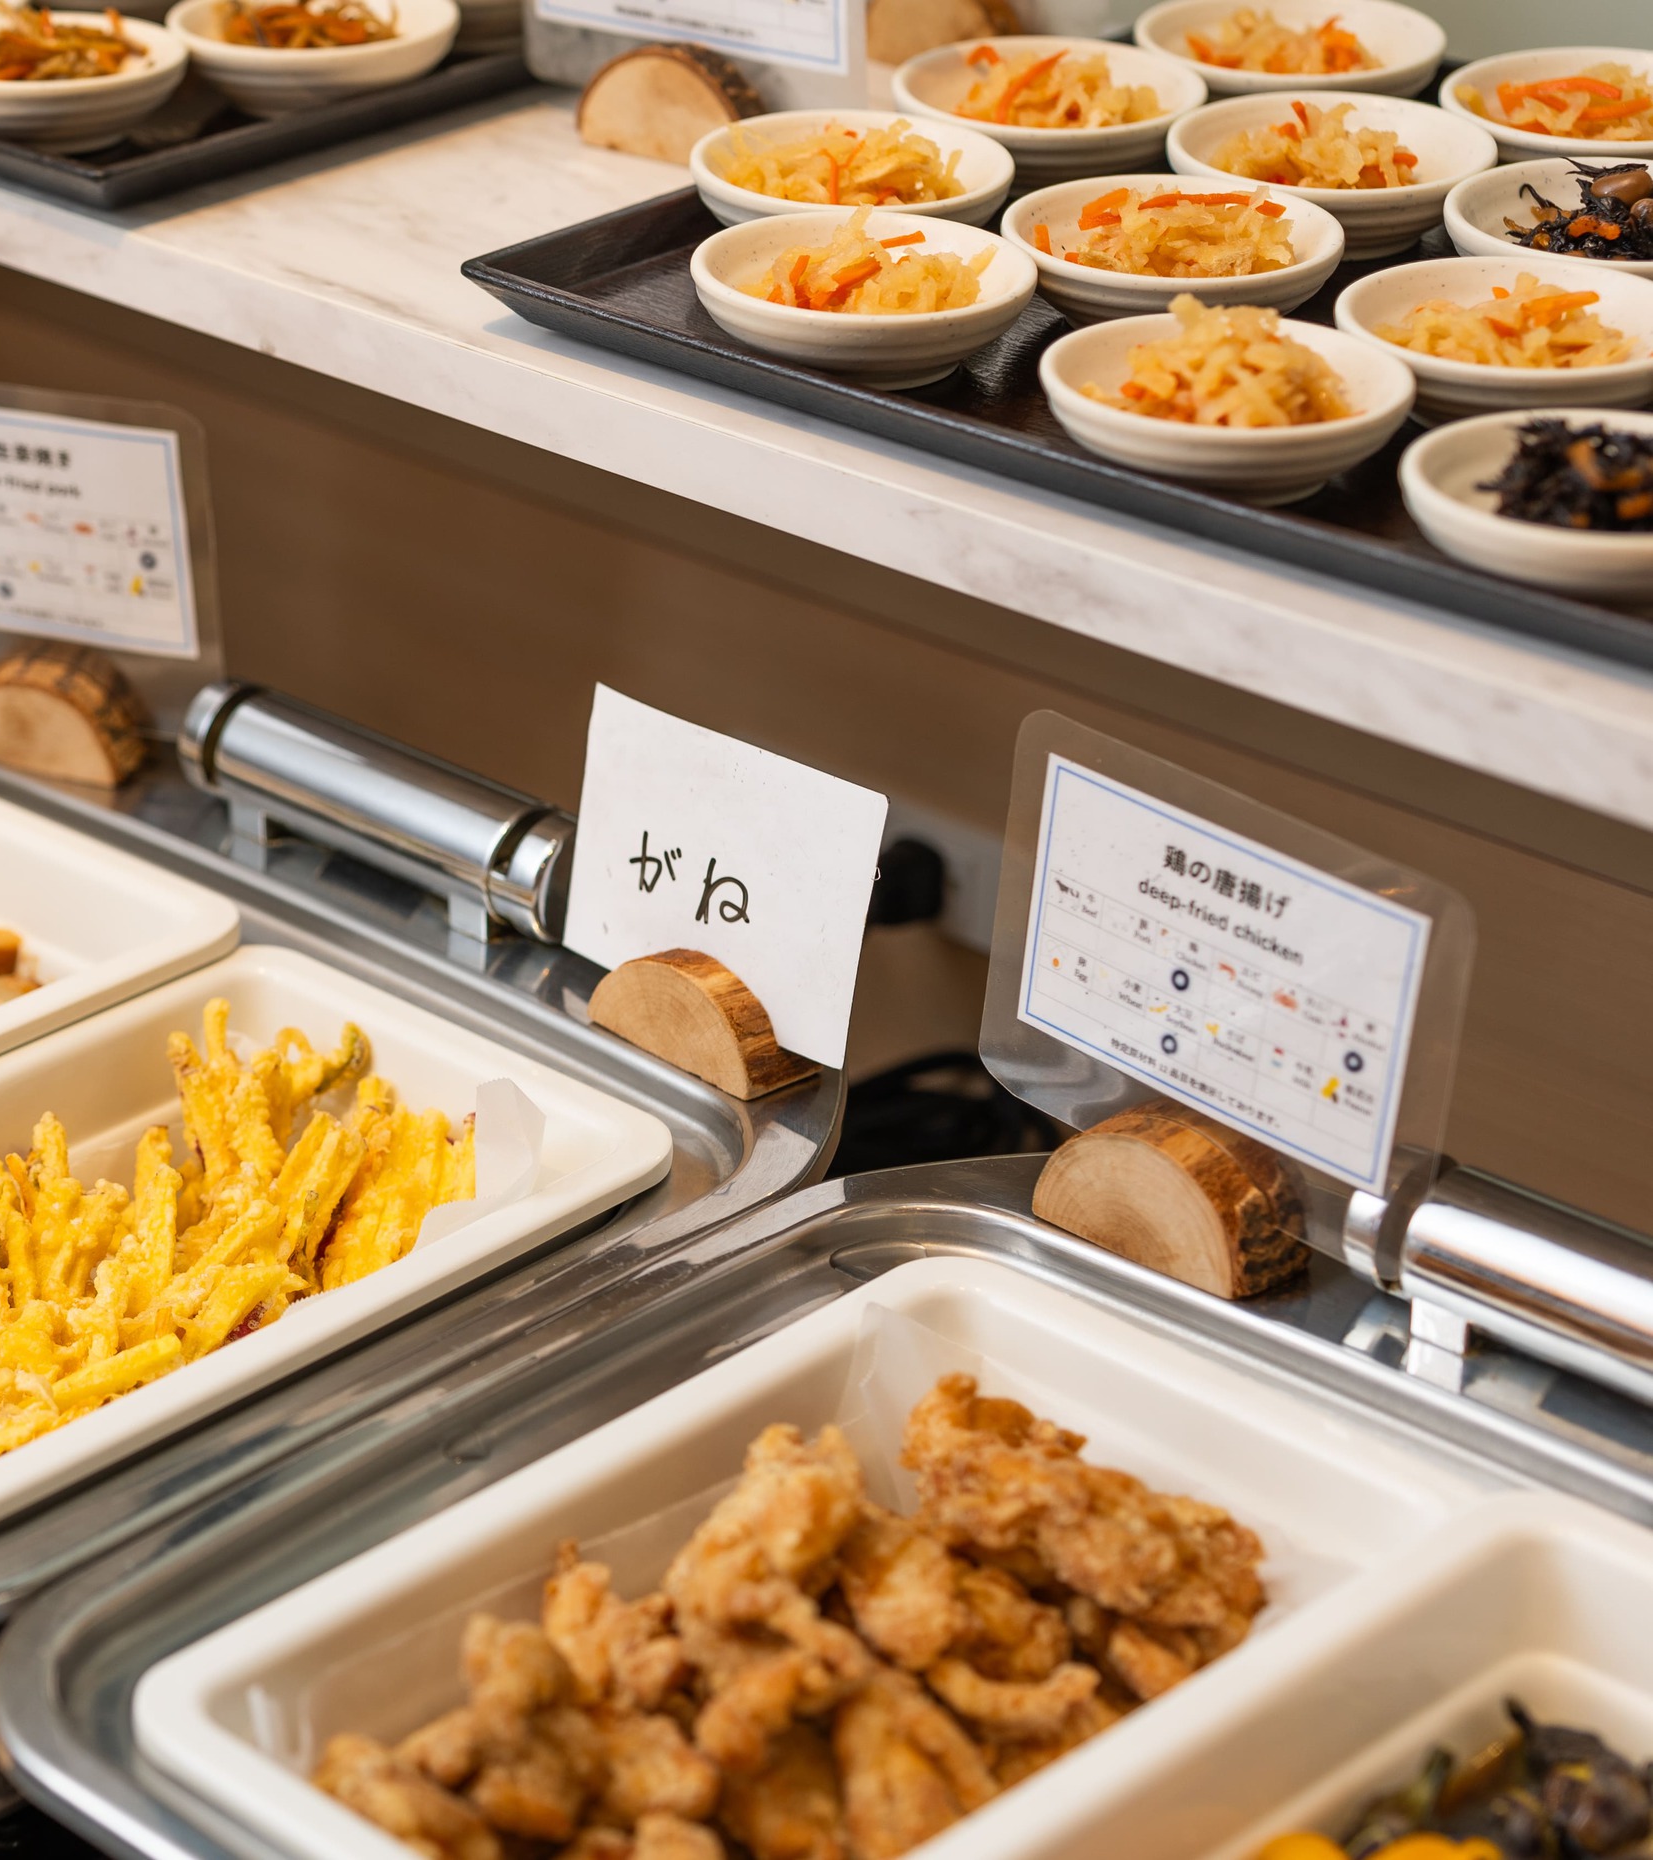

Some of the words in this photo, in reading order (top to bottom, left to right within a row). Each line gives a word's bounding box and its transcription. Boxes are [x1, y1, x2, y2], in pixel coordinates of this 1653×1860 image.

[629, 830, 750, 924] がね
[1163, 844, 1290, 919] 鶏の唐揚げ
[1138, 879, 1229, 931] deep-fried
[1233, 923, 1304, 967] chicken
